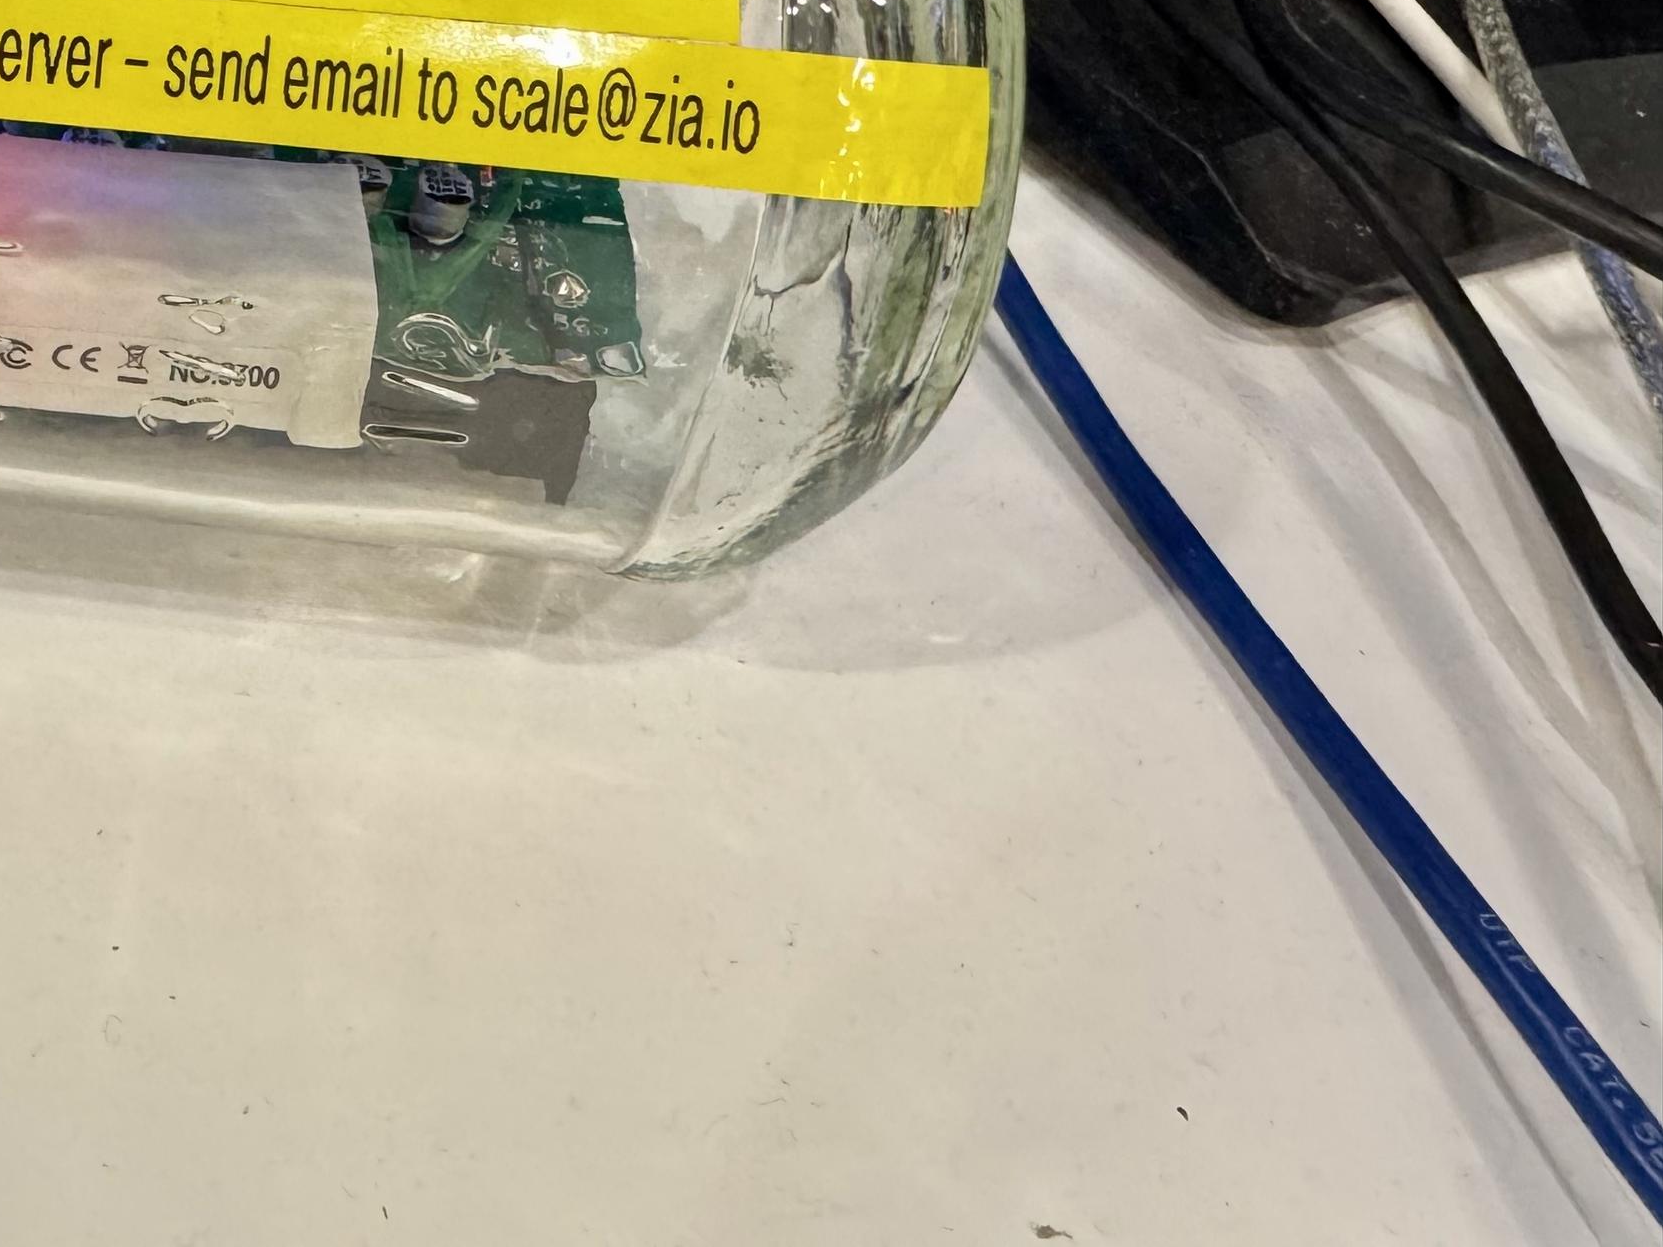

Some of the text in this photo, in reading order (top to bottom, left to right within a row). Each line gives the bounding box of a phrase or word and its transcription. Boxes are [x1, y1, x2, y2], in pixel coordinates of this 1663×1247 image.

[165, 36, 270, 105] send
[284, 54, 402, 117] email
[419, 62, 457, 123] to
[473, 69, 759, 153] scale@zia.io
